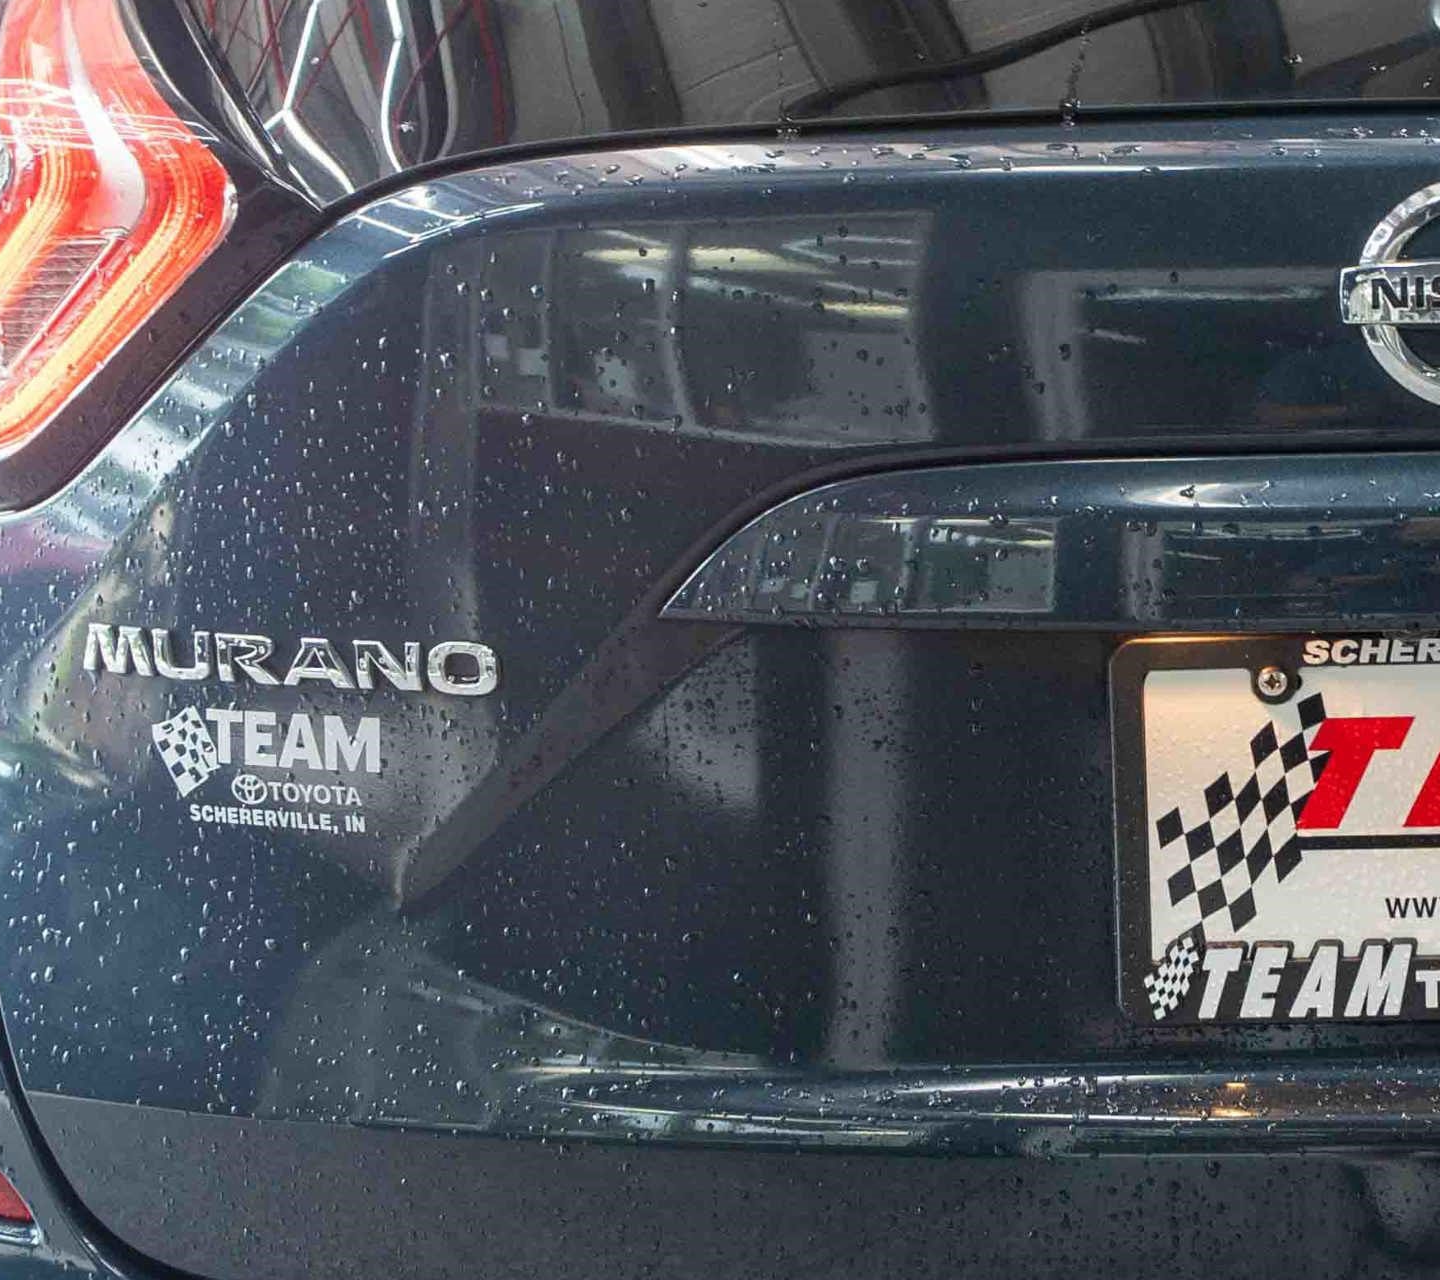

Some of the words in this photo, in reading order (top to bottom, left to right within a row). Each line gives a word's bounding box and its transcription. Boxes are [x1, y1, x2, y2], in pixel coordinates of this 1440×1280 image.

[82, 623, 499, 696] MURANO
[205, 707, 381, 773] TEAM
[189, 804, 338, 833] SCHERERVILLE,
[345, 814, 366, 833] IN
[268, 783, 362, 807] TOYOTA
[1198, 944, 1417, 1019] TEAM
